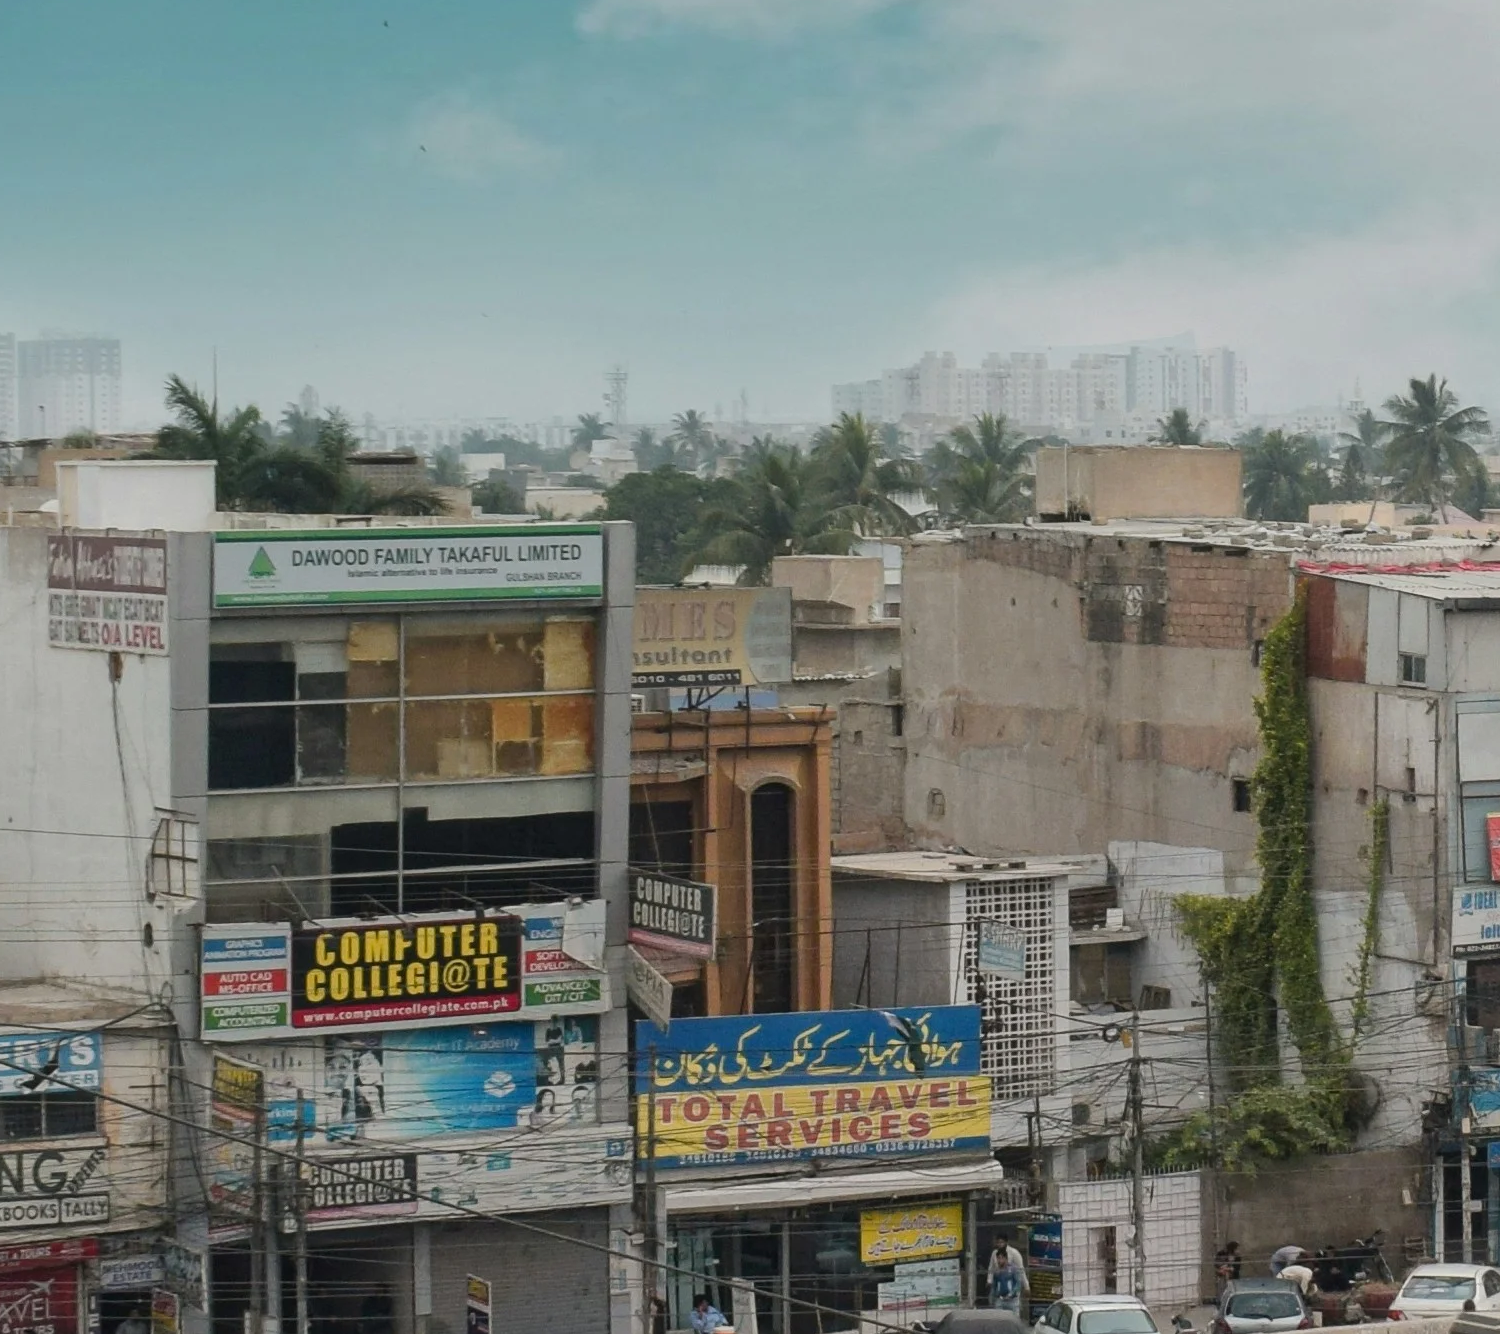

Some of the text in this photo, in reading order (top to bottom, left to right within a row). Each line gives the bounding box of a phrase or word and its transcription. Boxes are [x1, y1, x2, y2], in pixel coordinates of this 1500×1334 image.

[292, 544, 582, 567] DAWOOD FAMILY TAKAFUL LIMITED
[455, 566, 498, 576] insurance
[506, 571, 582, 582] GULSHAN BRANCH
[125, 624, 165, 649] LEVEL
[637, 876, 702, 912] COMPUTER
[1474, 891, 1498, 910] IDEAL
[633, 901, 705, 939] COLLEGI@TE
[315, 922, 498, 967] COMPUTER
[219, 971, 273, 982] AUTO CAD
[219, 982, 273, 994] MS-OFFICE
[305, 955, 509, 1002] COLLEGI@TE
[533, 981, 591, 994] ADVANCED
[218, 1016, 277, 1028] ACCOUNTING
[303, 997, 509, 1023] www.computercollegiate.com.pk
[656, 1080, 978, 1124] TOTAL TRAVEL
[705, 1112, 933, 1152] SERVICES
[308, 1158, 405, 1186] COMPUTER
[64, 1199, 107, 1218] TALLY
